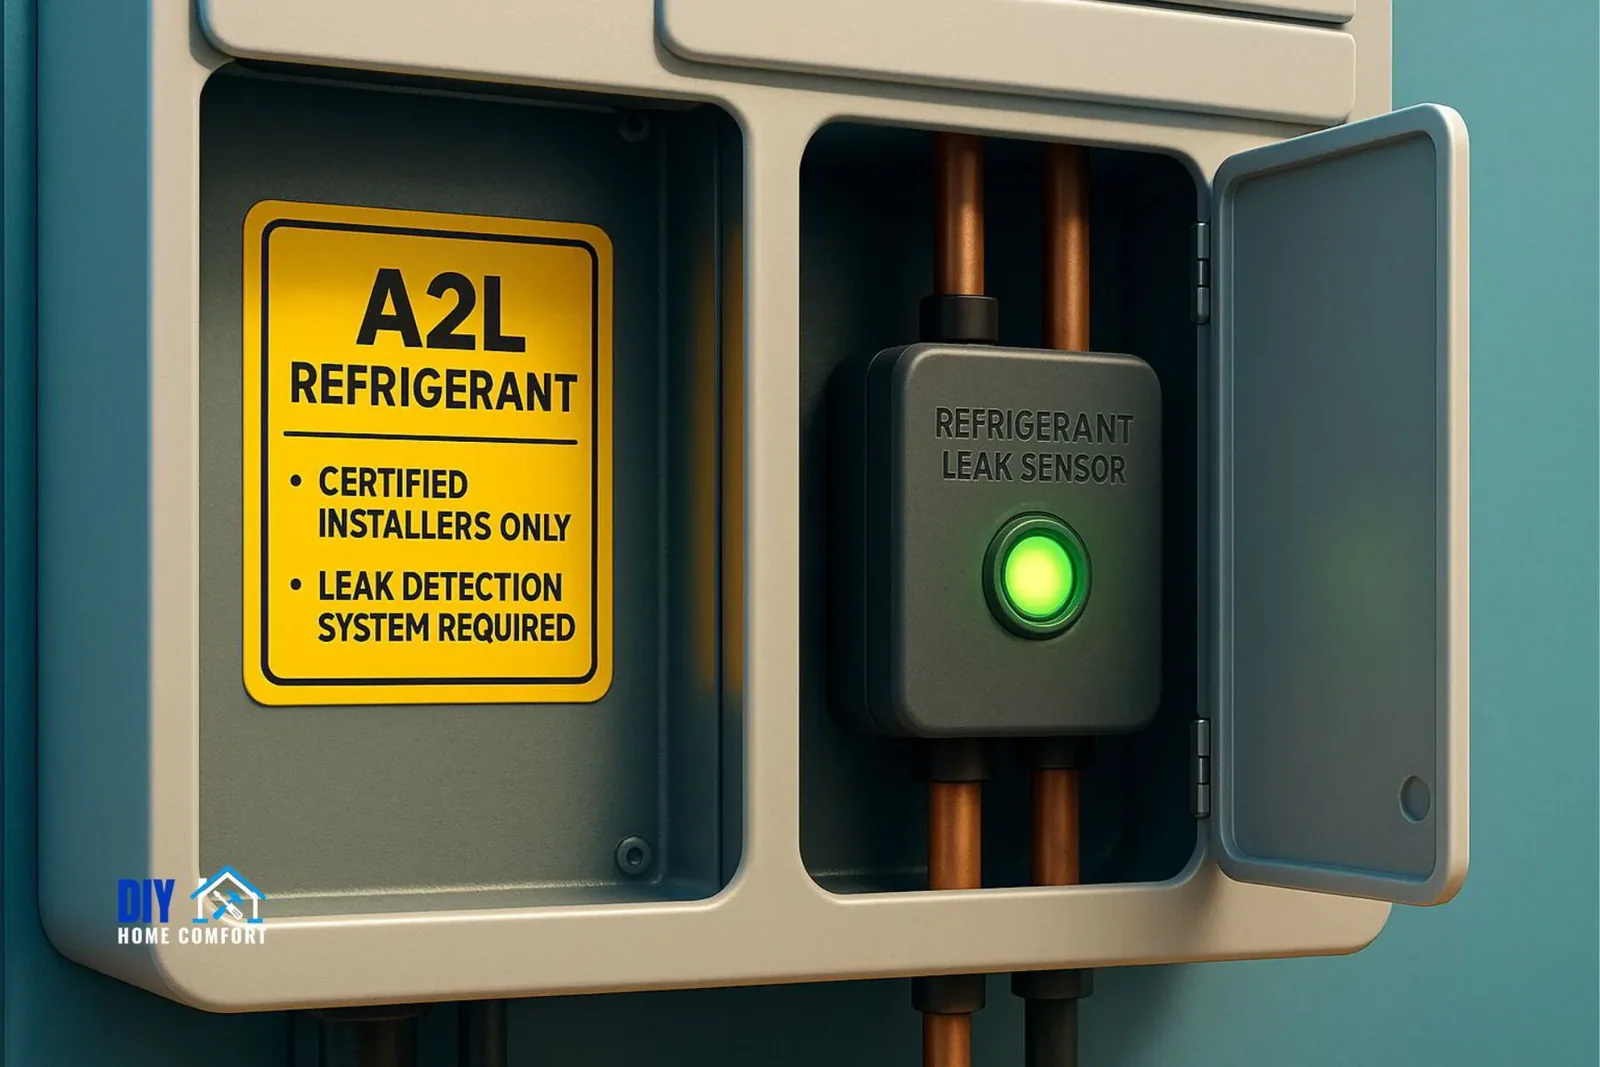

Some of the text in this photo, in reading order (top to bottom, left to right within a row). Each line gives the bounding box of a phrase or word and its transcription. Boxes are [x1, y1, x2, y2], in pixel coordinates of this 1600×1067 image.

[356, 268, 526, 352] A2L
[291, 362, 578, 412] REFRIGERANT
[935, 407, 1133, 444] REFRIGERANT
[319, 466, 468, 499] CERTIFIED
[942, 450, 1127, 484] LEAK SENSOR
[319, 509, 572, 542] INSTALLERS ONLY
[319, 571, 562, 602] LEAK DETECTION
[318, 613, 576, 644] SYSTEM REQUIRED
